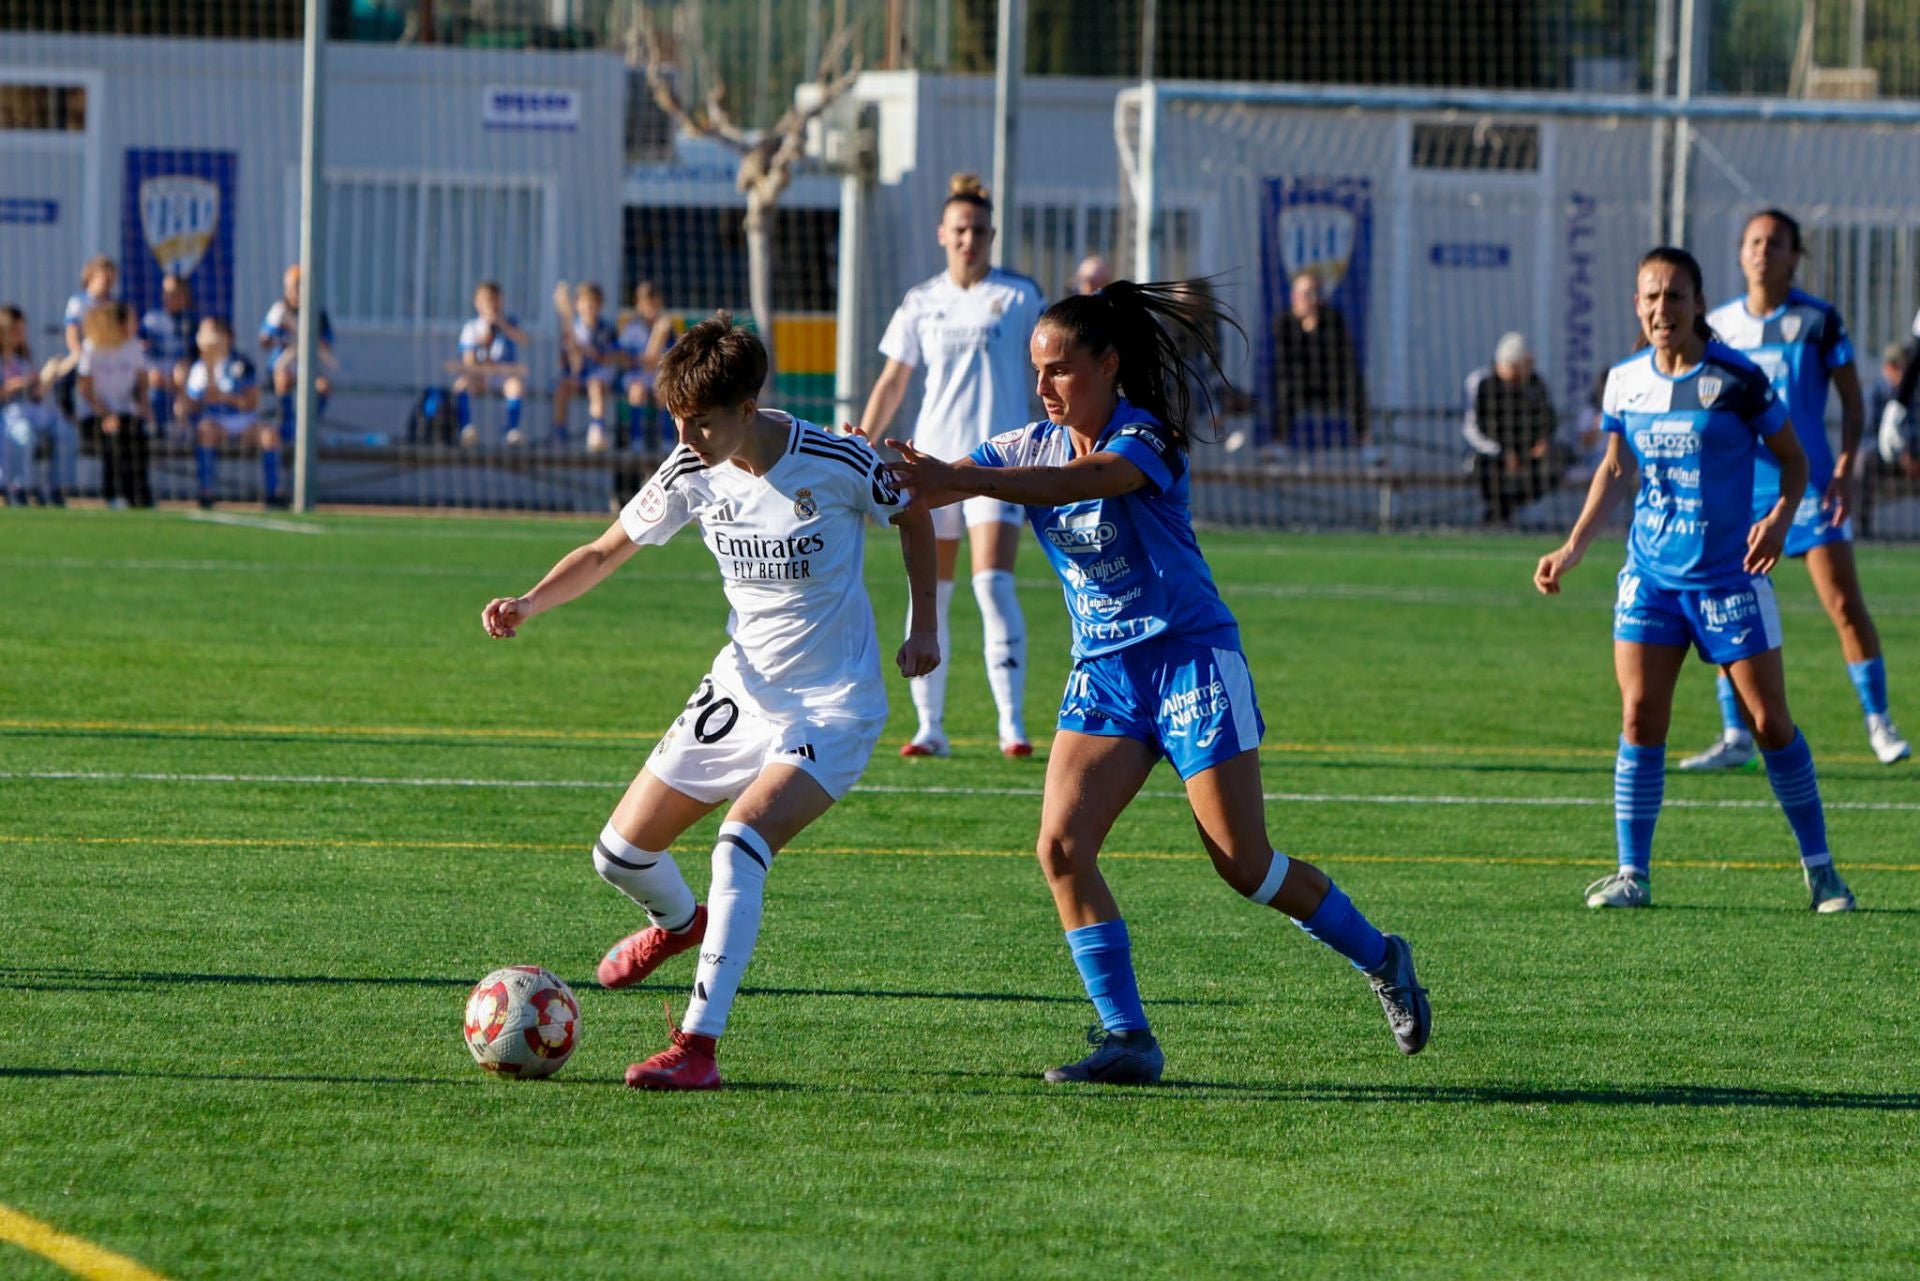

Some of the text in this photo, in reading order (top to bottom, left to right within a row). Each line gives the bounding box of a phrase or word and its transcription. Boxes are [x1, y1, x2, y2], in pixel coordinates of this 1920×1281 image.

[715, 532, 824, 559] Emirates
[734, 560, 811, 579] FLY BETTER
[1163, 679, 1224, 716] Alhama
[1171, 697, 1229, 730] Nature
